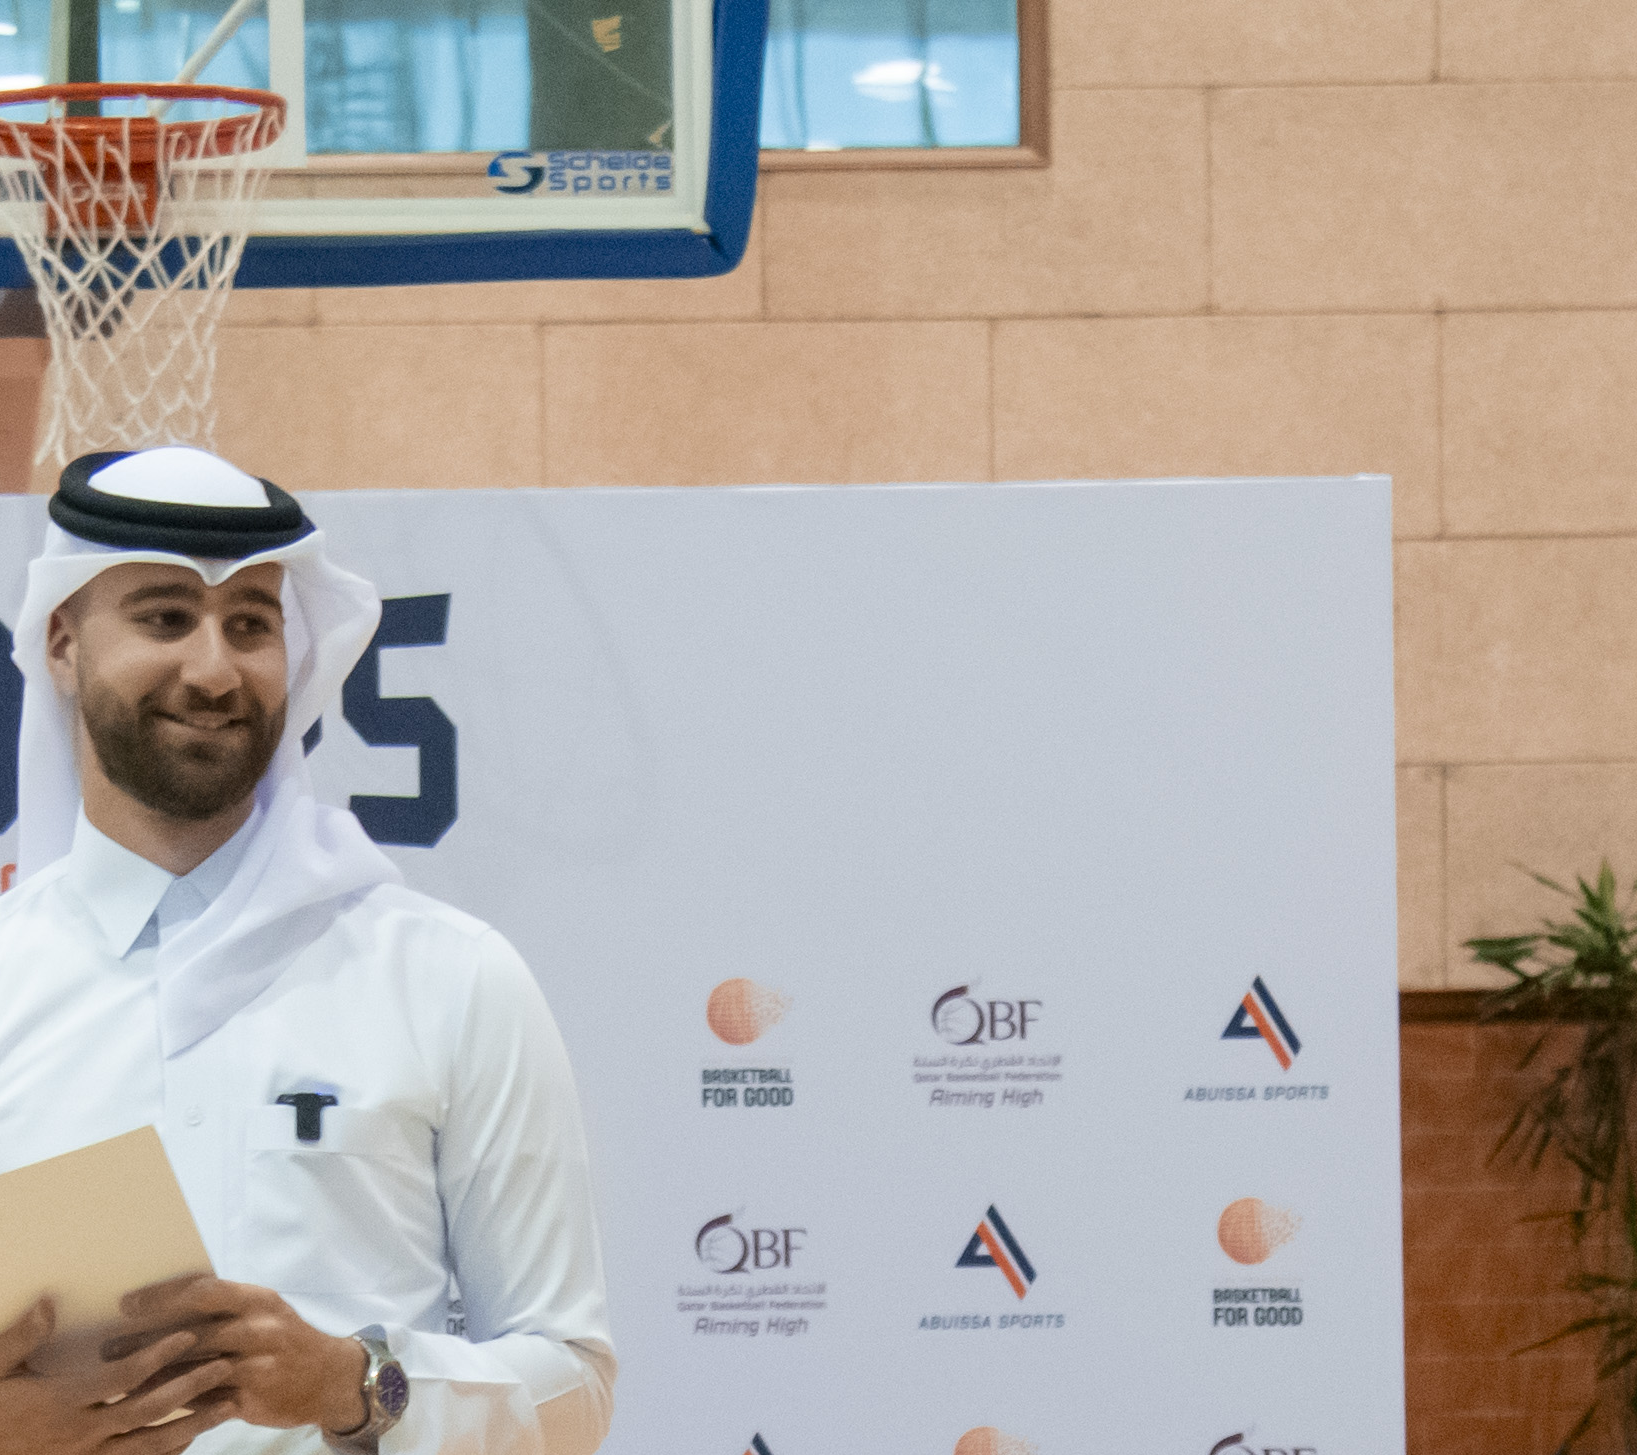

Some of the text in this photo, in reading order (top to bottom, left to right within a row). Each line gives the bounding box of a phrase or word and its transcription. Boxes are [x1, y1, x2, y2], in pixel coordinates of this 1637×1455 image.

[548, 171, 671, 195] Sports
[930, 985, 1043, 1047] QBF
[702, 1069, 792, 1085] BASKETBALL
[703, 1087, 794, 1107] FOR GOOD
[1184, 1085, 1329, 1102] ABUISSA SPORTS
[694, 1213, 807, 1275] QBF
[1212, 1288, 1302, 1304] BASKETBALL
[918, 1313, 1064, 1330] ABUISSA SPORTS
[1213, 1306, 1304, 1326] FOR GOOD
